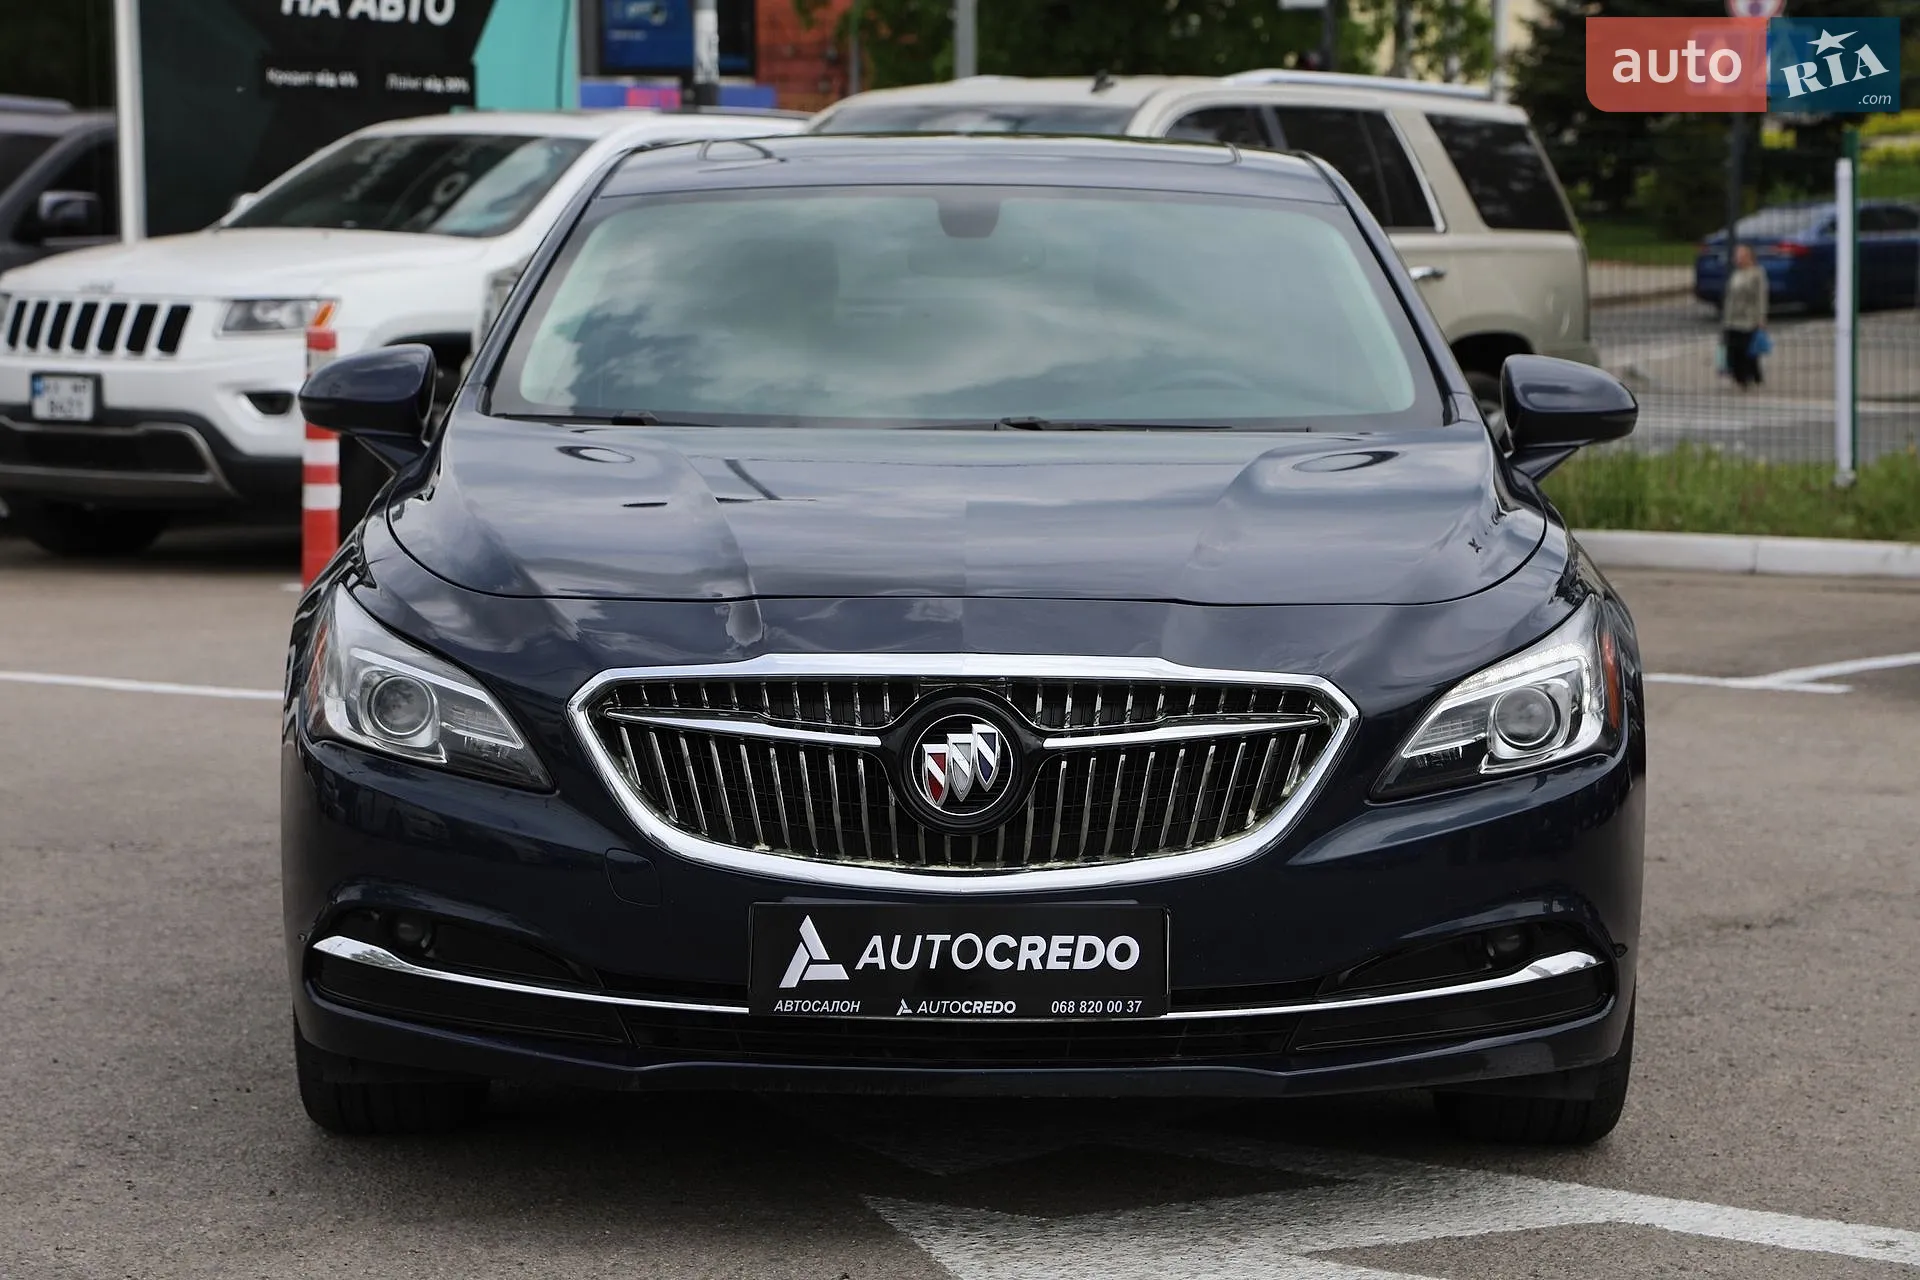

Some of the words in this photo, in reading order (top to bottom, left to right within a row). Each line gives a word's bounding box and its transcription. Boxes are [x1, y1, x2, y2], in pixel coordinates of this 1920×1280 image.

[854, 933, 1141, 971] AUTOCREDO
[773, 999, 861, 1013] АВТОСАЛОН
[917, 1000, 1017, 1014] AUTOCREDO
[1051, 1000, 1076, 1014] 068
[1079, 1000, 1103, 1014] 820
[1106, 1000, 1123, 1014] 00
[1126, 1000, 1143, 1014] 37
